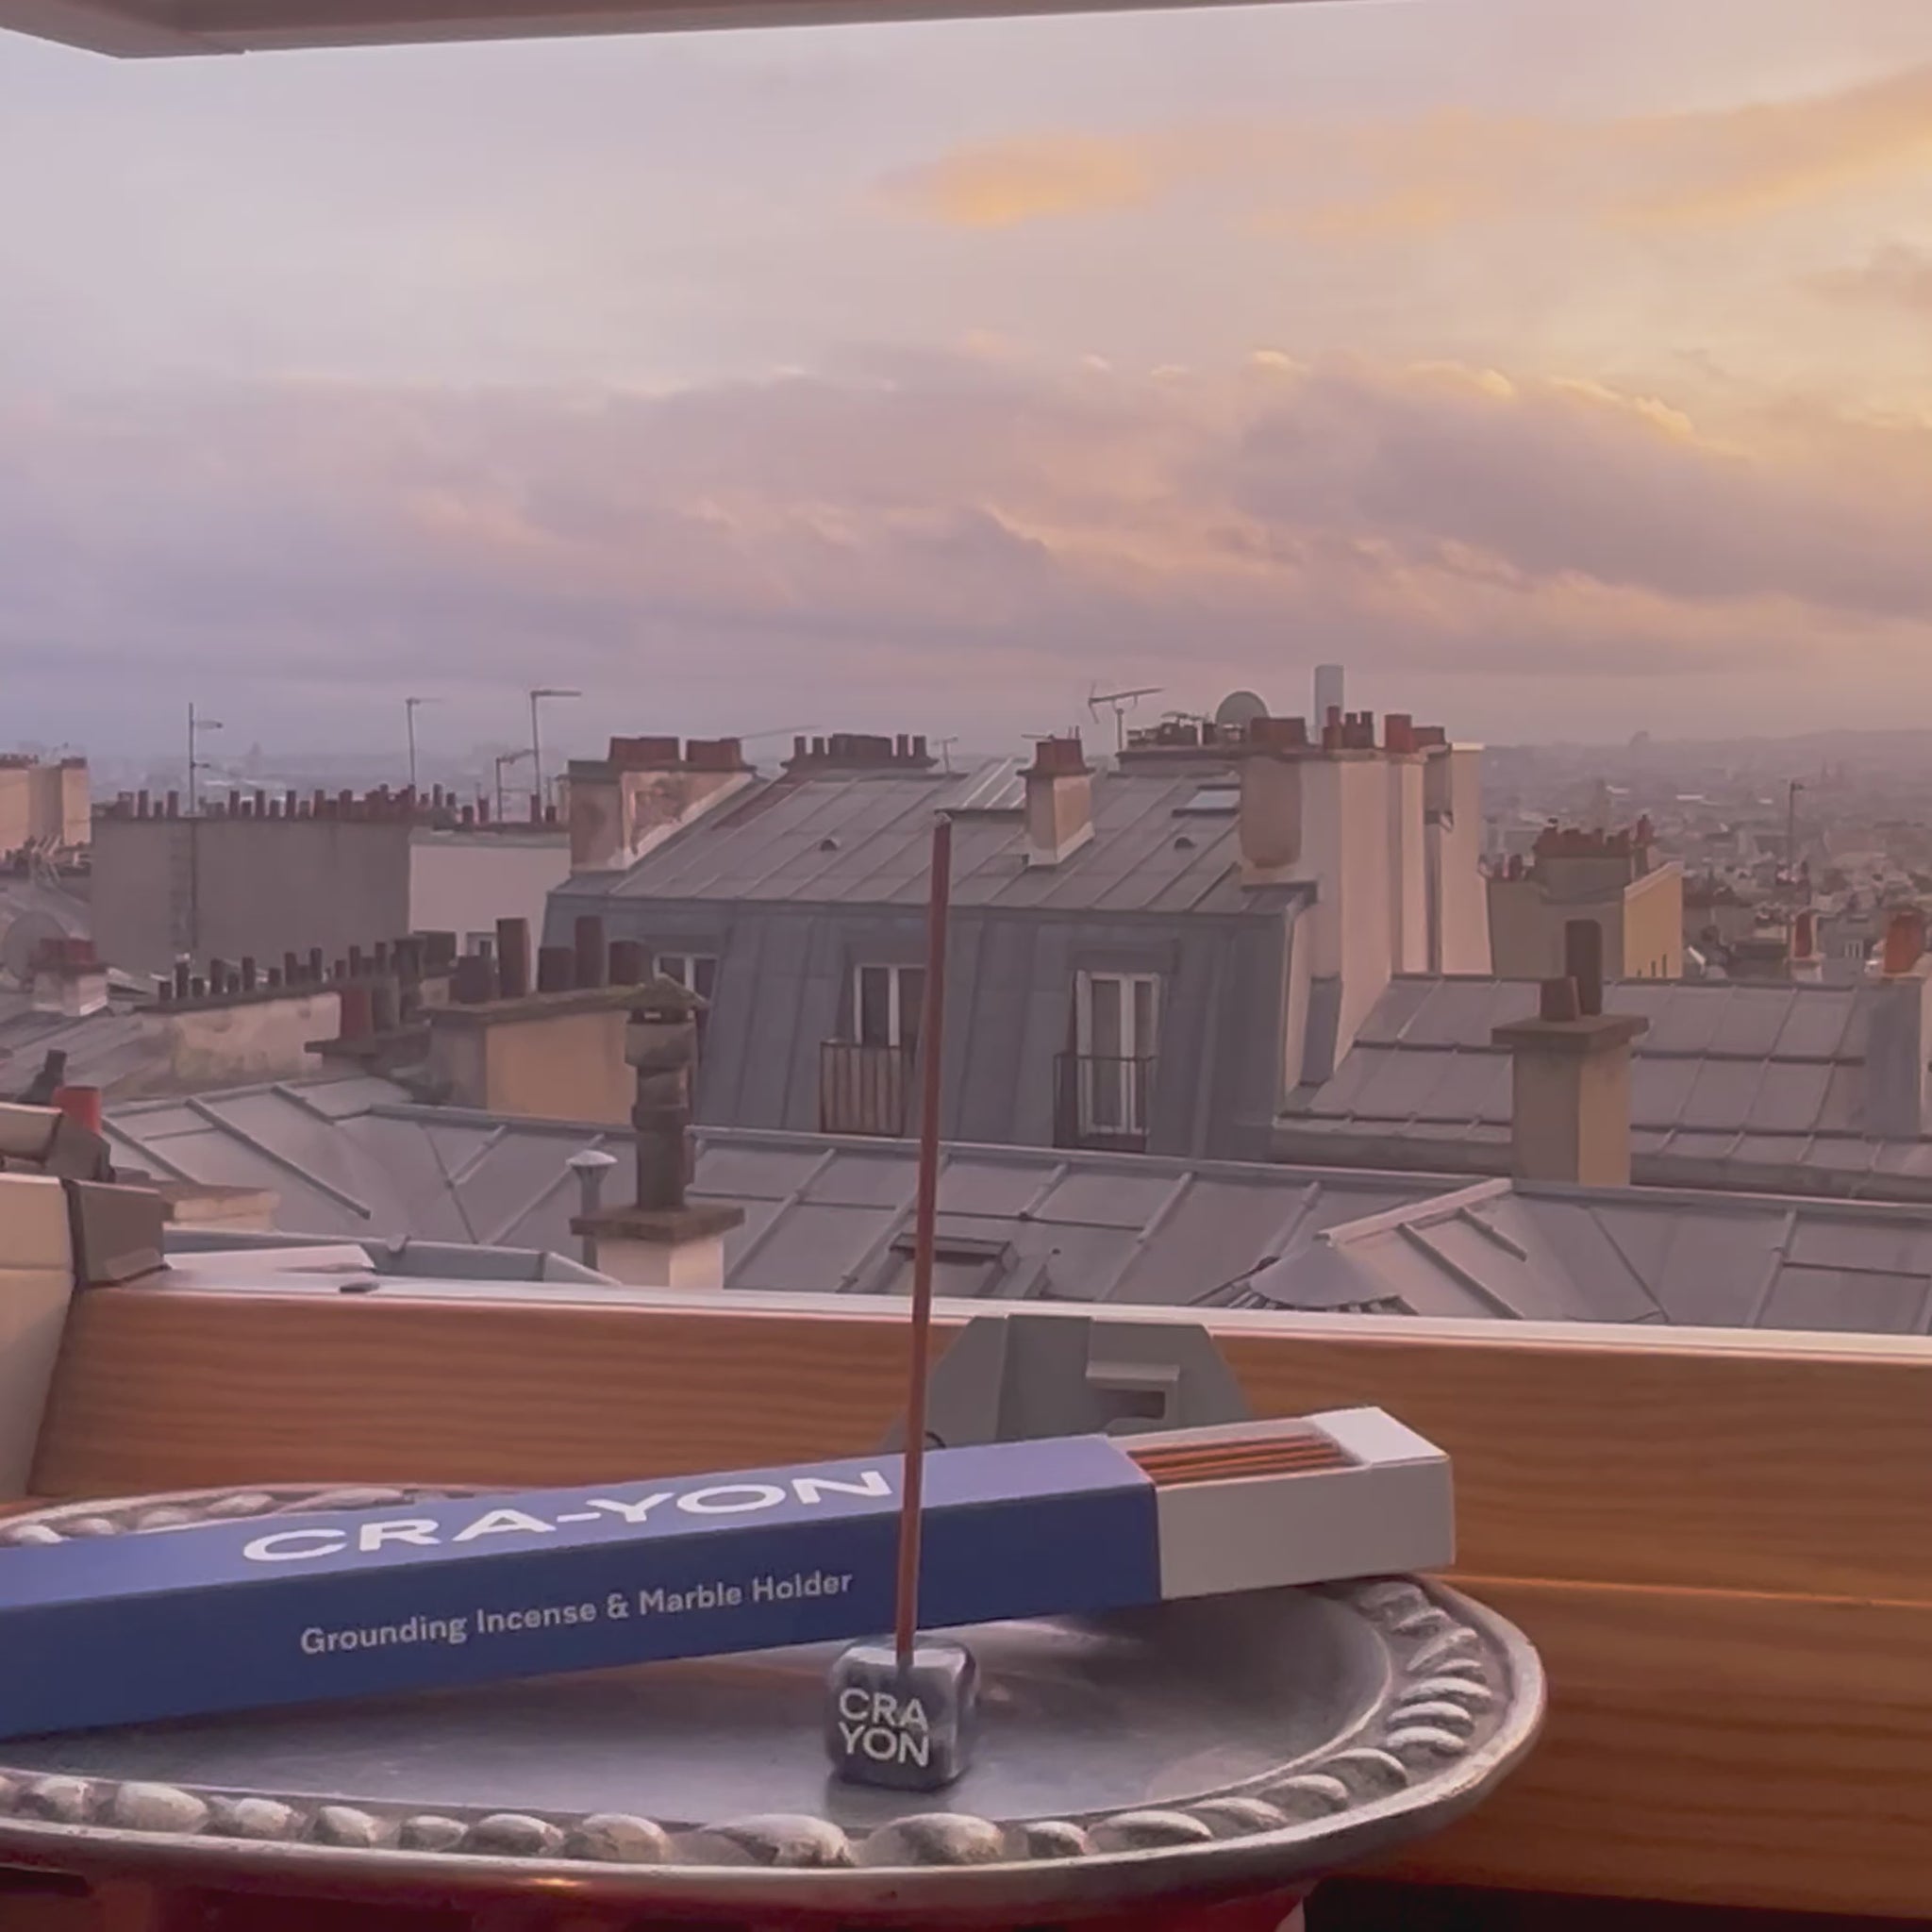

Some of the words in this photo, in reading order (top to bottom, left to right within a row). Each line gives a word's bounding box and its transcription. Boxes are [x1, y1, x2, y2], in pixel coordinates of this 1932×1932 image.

[242, 1470, 893, 1562] CRA-YON
[301, 1615, 468, 1654] Grounding
[478, 1602, 596, 1633] Incense
[607, 1593, 629, 1620] &
[640, 1582, 741, 1615] Marble
[753, 1571, 853, 1603] Holder
[839, 1687, 929, 1732] CRA
[838, 1721, 930, 1767] YON
